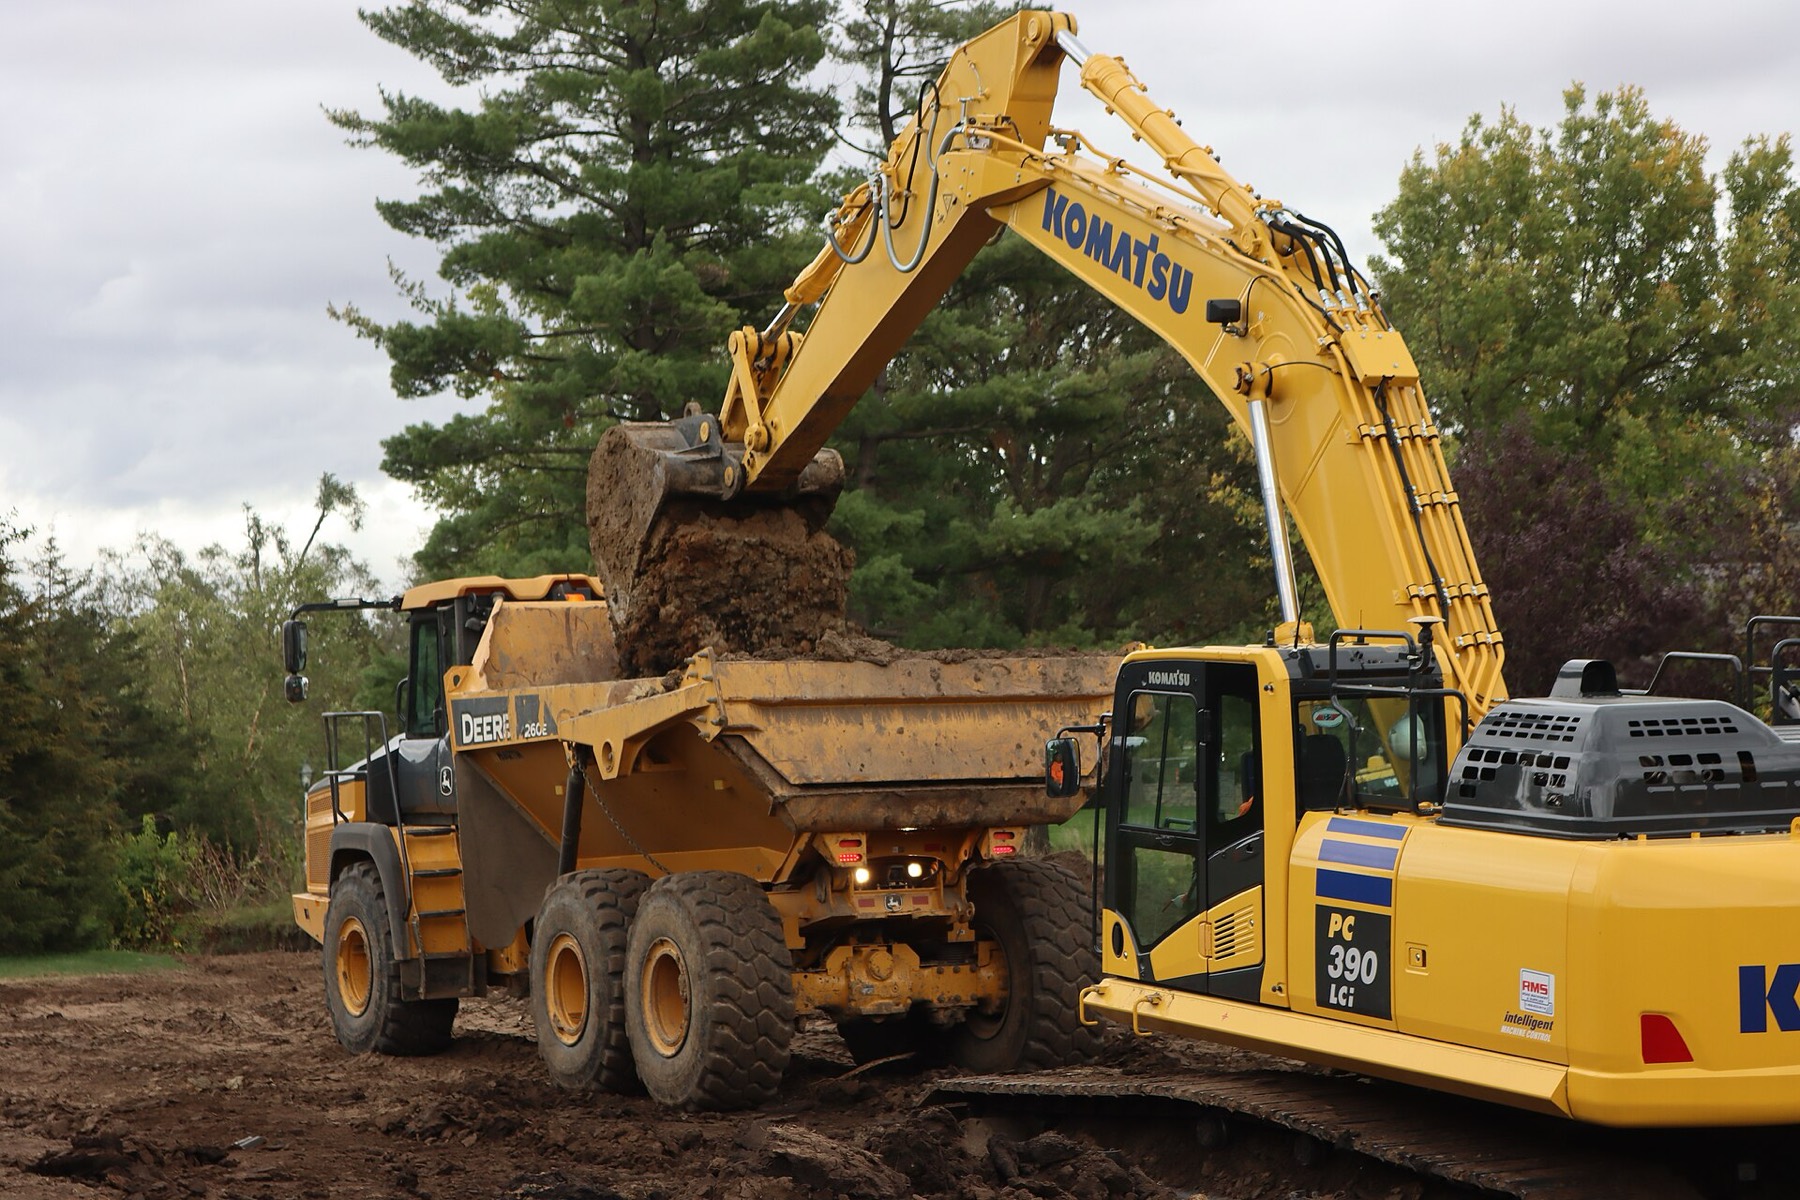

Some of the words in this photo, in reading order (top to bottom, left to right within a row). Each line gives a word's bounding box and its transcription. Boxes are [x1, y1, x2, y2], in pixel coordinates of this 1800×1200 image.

[1042, 187, 1194, 315] KOMATSU
[1148, 669, 1190, 687] KOMATSU
[1327, 912, 1356, 941] PC
[1327, 944, 1378, 985] 390
[1329, 983, 1355, 1008] LCi
[1522, 980, 1548, 995] RMS
[1738, 963, 1800, 1034] K
[1500, 1025, 1527, 1037] MACHINE
[1526, 1030, 1552, 1042] CONTROL
[1504, 1011, 1554, 1031] intelligent
